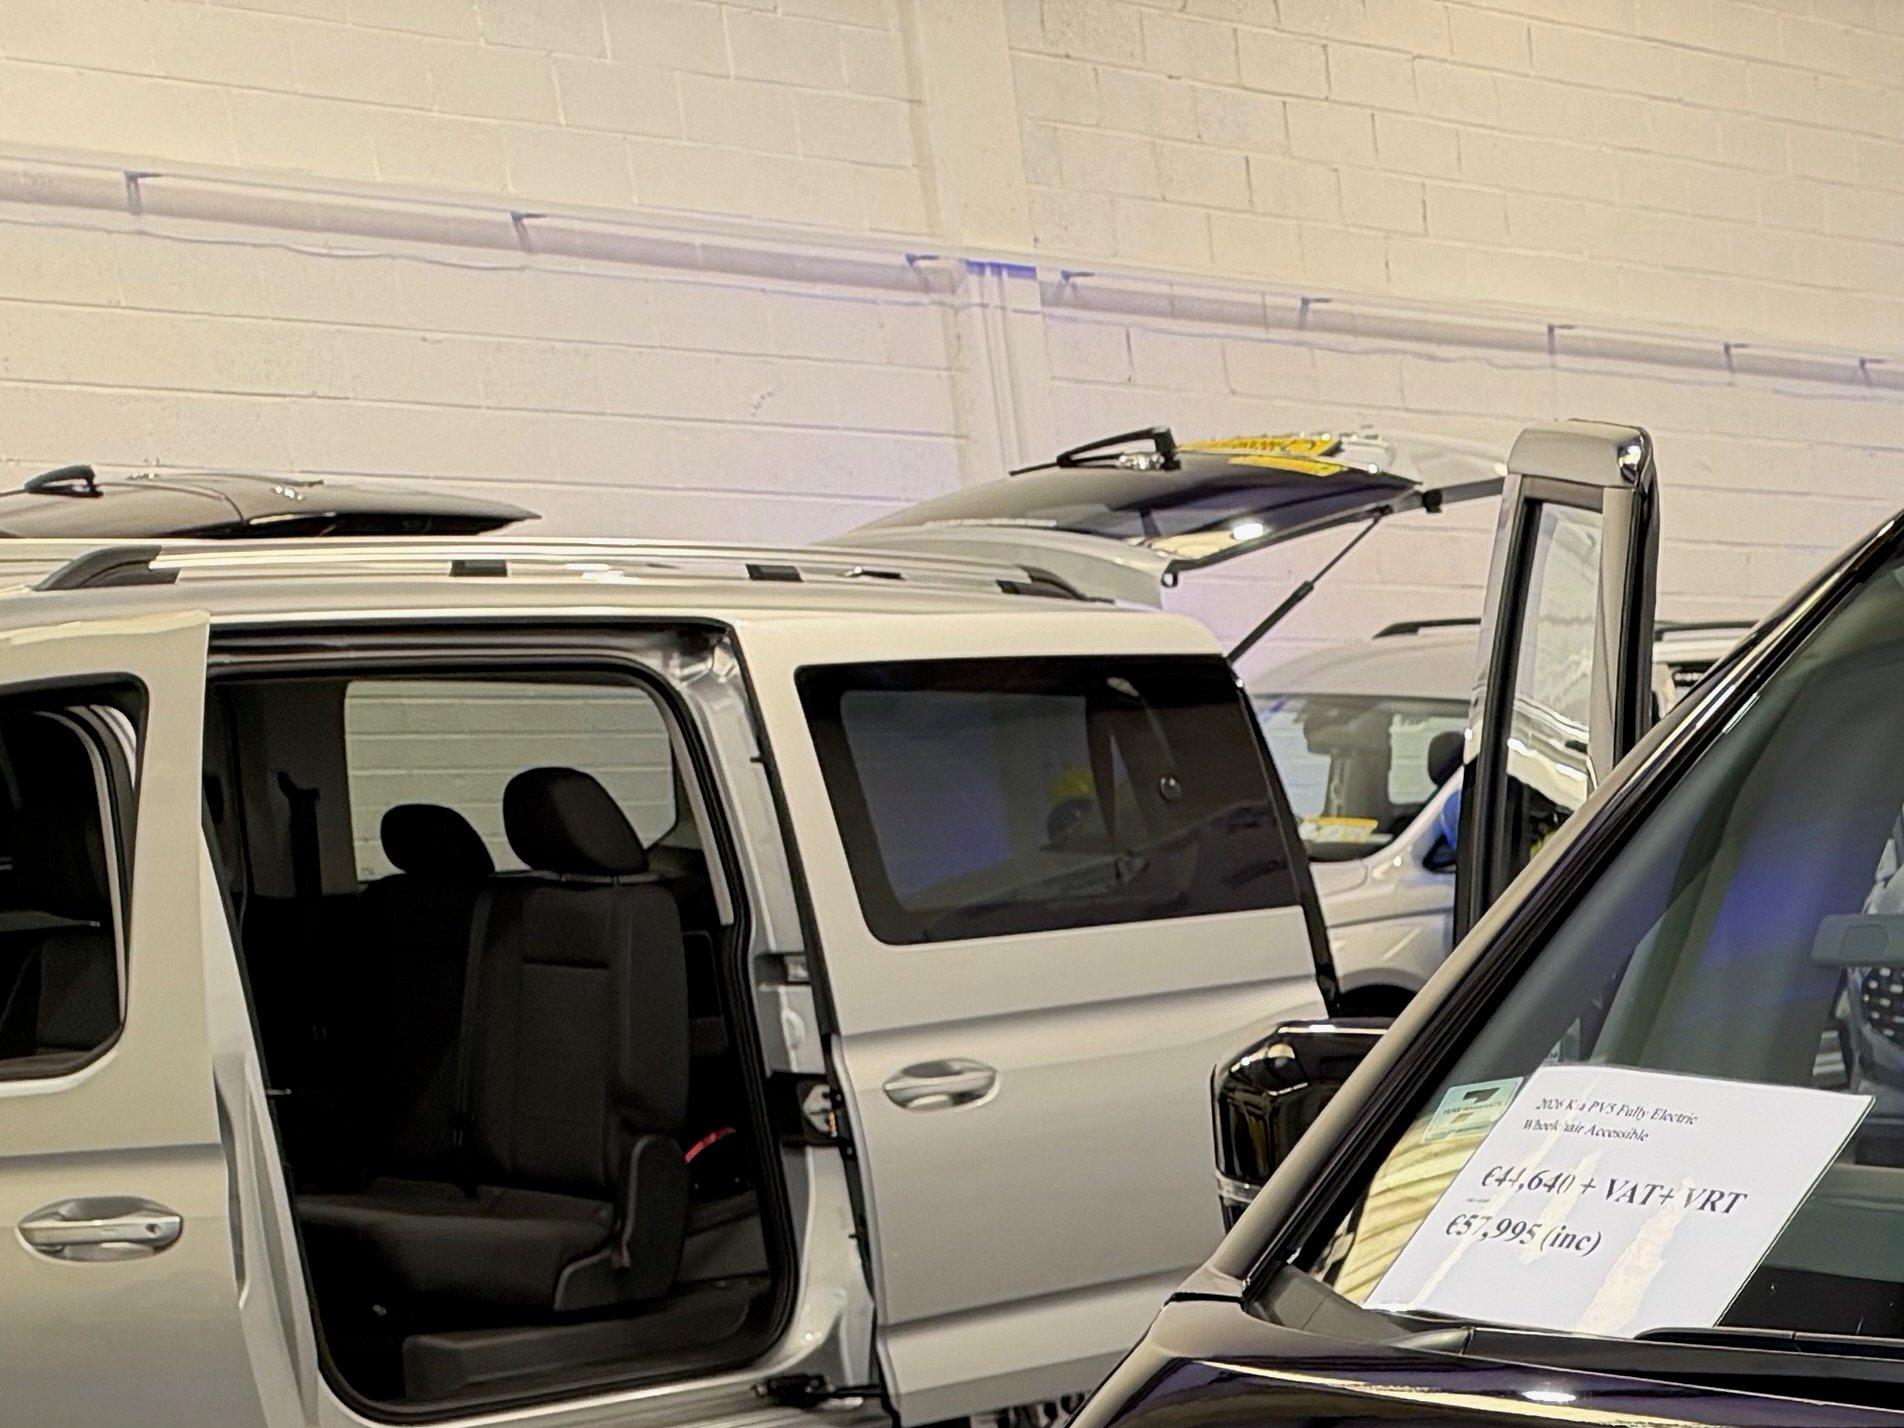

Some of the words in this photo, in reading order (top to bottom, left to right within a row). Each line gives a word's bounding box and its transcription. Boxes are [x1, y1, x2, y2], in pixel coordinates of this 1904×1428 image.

[1617, 1103, 1649, 1122] Fully
[1650, 1107, 1699, 1126] Electric
[1586, 1123, 1650, 1142] Accessible
[1580, 1176, 1597, 1195] +
[1683, 1186, 1749, 1216] VRT
[1539, 1224, 1603, 1257] (inc)
